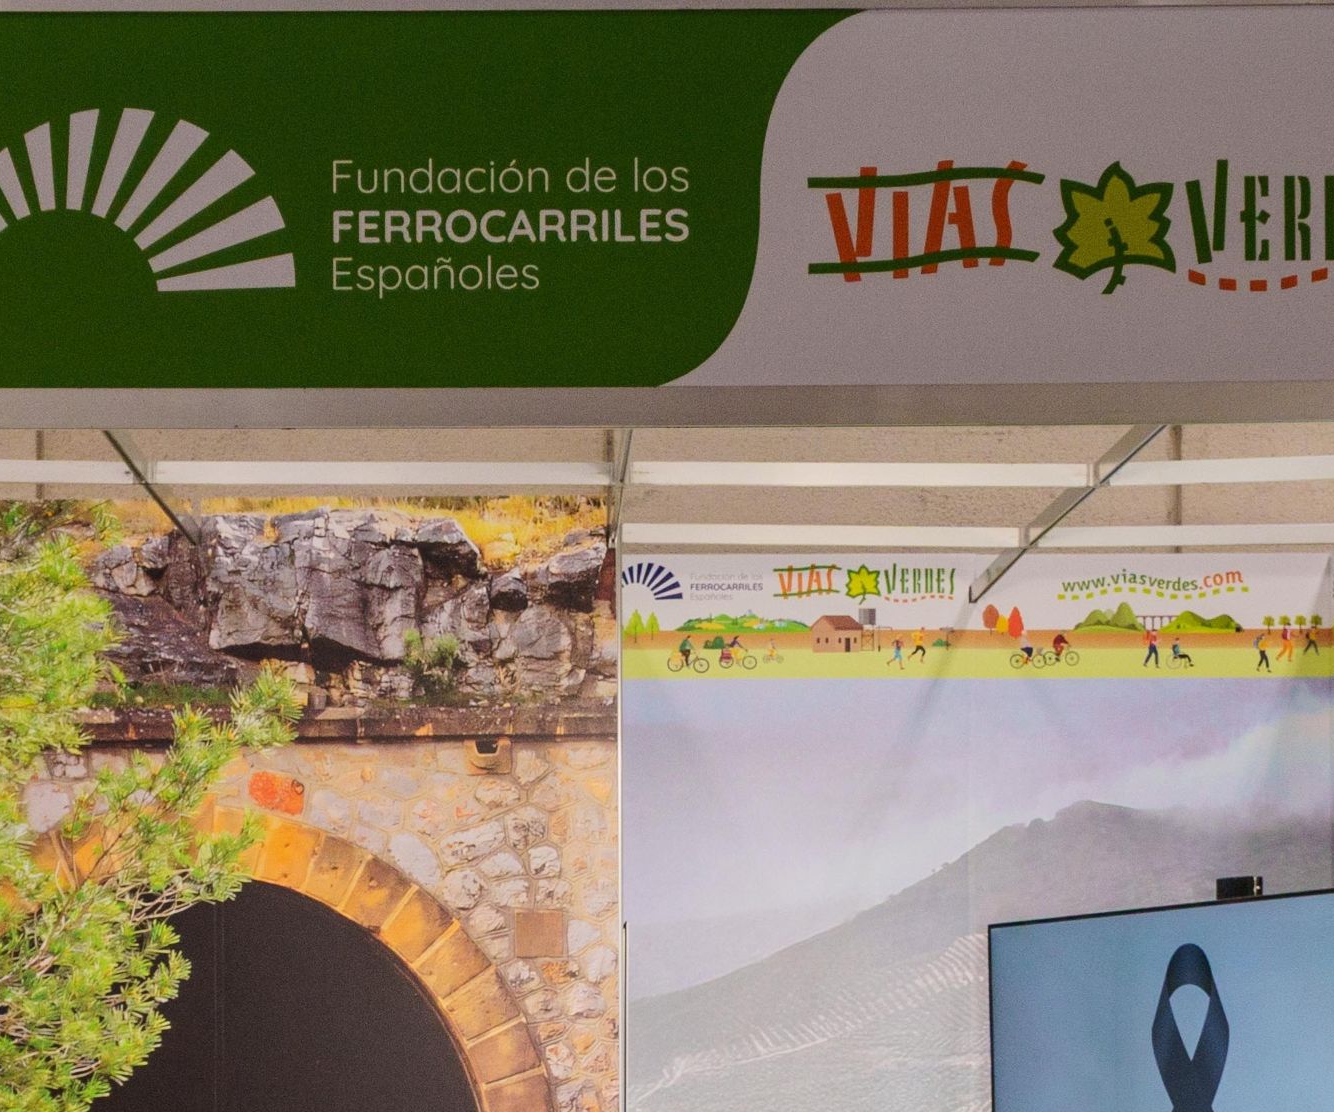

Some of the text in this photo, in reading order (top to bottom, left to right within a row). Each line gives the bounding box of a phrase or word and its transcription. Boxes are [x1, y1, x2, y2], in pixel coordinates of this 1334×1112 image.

[332, 157, 690, 194] Fundación de los
[332, 208, 690, 244] FERROCARRILES
[809, 160, 1044, 282] VIAS
[332, 255, 540, 299] Españoles
[690, 582, 764, 592] FERROCARRILES
[690, 592, 734, 603] Españoles
[774, 563, 956, 599] VIAS VERDES
[1061, 568, 1244, 593] www.viasverdes.com
